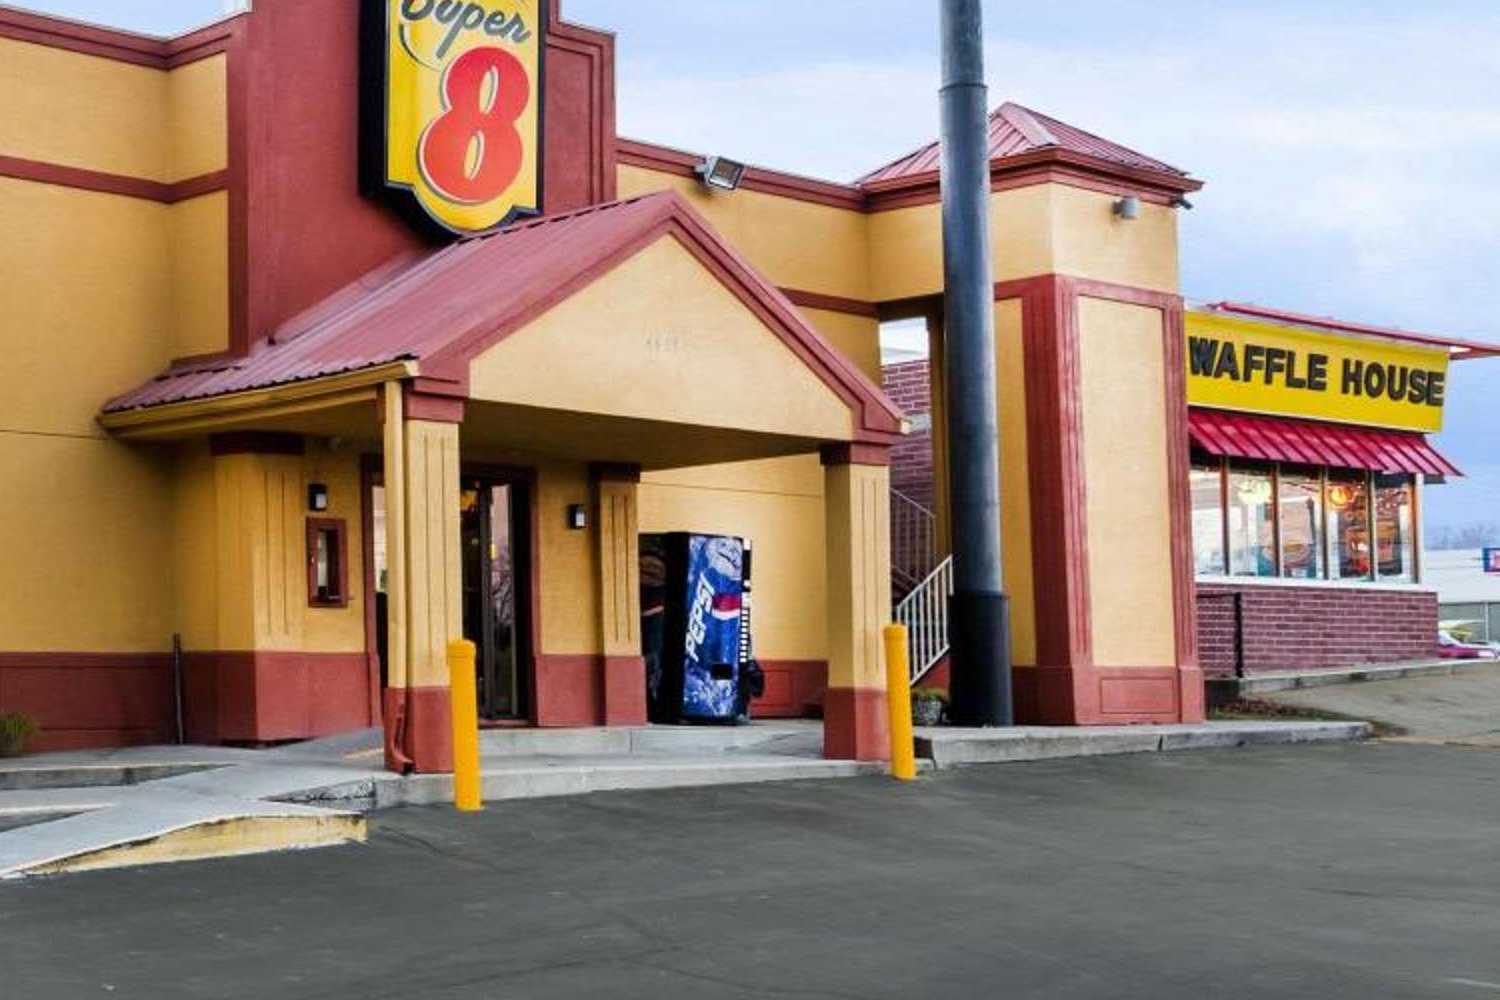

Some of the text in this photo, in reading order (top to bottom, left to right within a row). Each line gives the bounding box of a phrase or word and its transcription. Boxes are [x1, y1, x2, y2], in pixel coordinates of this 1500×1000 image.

[416, 46, 530, 206] 8
[1187, 336, 1445, 407] WAFFLE HOUSE
